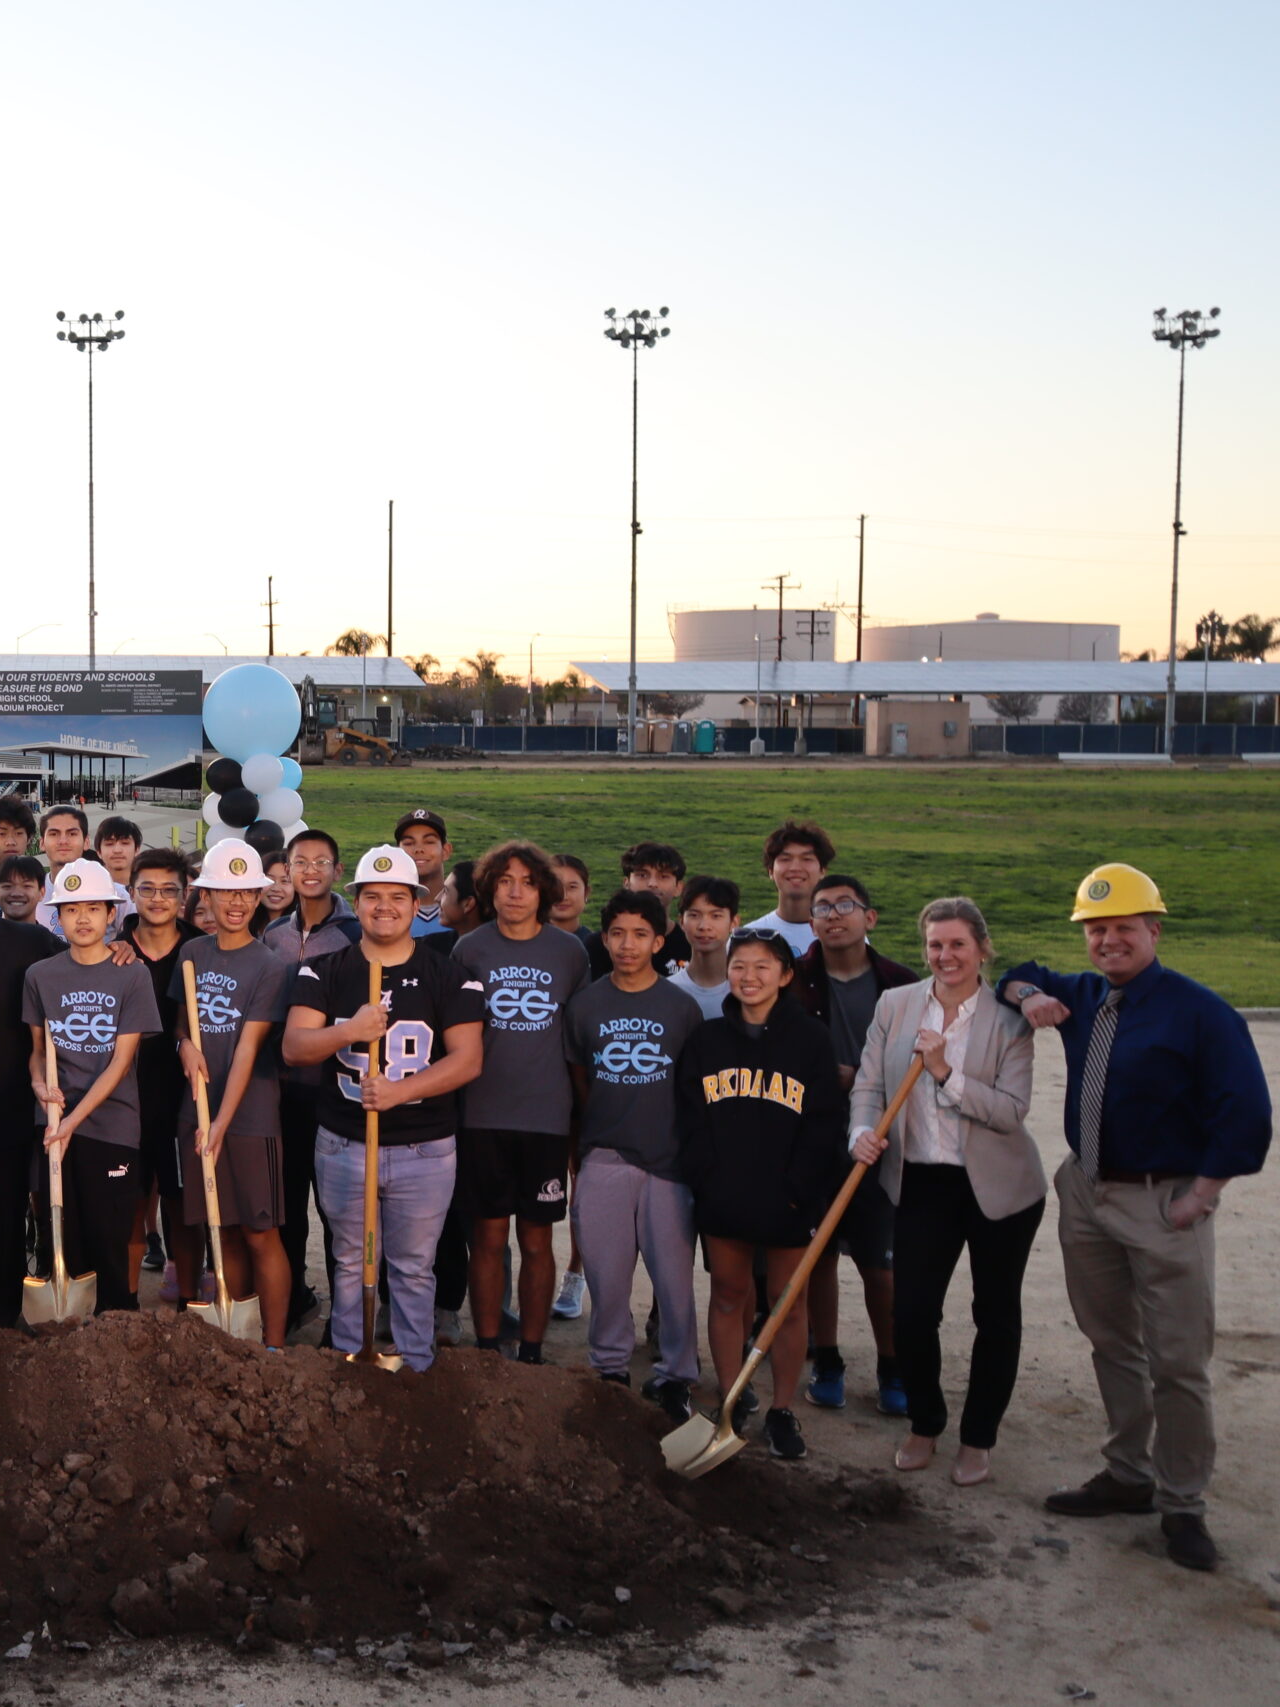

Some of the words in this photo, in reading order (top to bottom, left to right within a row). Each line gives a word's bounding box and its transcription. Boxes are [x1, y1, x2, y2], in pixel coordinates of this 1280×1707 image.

[6, 673, 28, 681] OUR
[30, 673, 81, 681] STUDENTS
[84, 673, 105, 681] AND
[107, 673, 156, 681] SCHOOLS
[38, 684, 52, 692] HS
[54, 684, 83, 692] BOND
[60, 733, 86, 747] HOME
[87, 738, 98, 749] OF
[98, 740, 113, 751] THE
[489, 966, 553, 985] ARROYO
[503, 980, 536, 988] KNIGHTS
[61, 991, 116, 1008] ARROYO
[491, 1018, 507, 1029] OSS
[599, 1018, 664, 1037] ARROYO
[52, 1035, 82, 1052] CROSS
[613, 1033, 647, 1041] KNIGHTS
[596, 1070, 619, 1083] ROSS
[622, 1069, 667, 1084] COUNTRY
